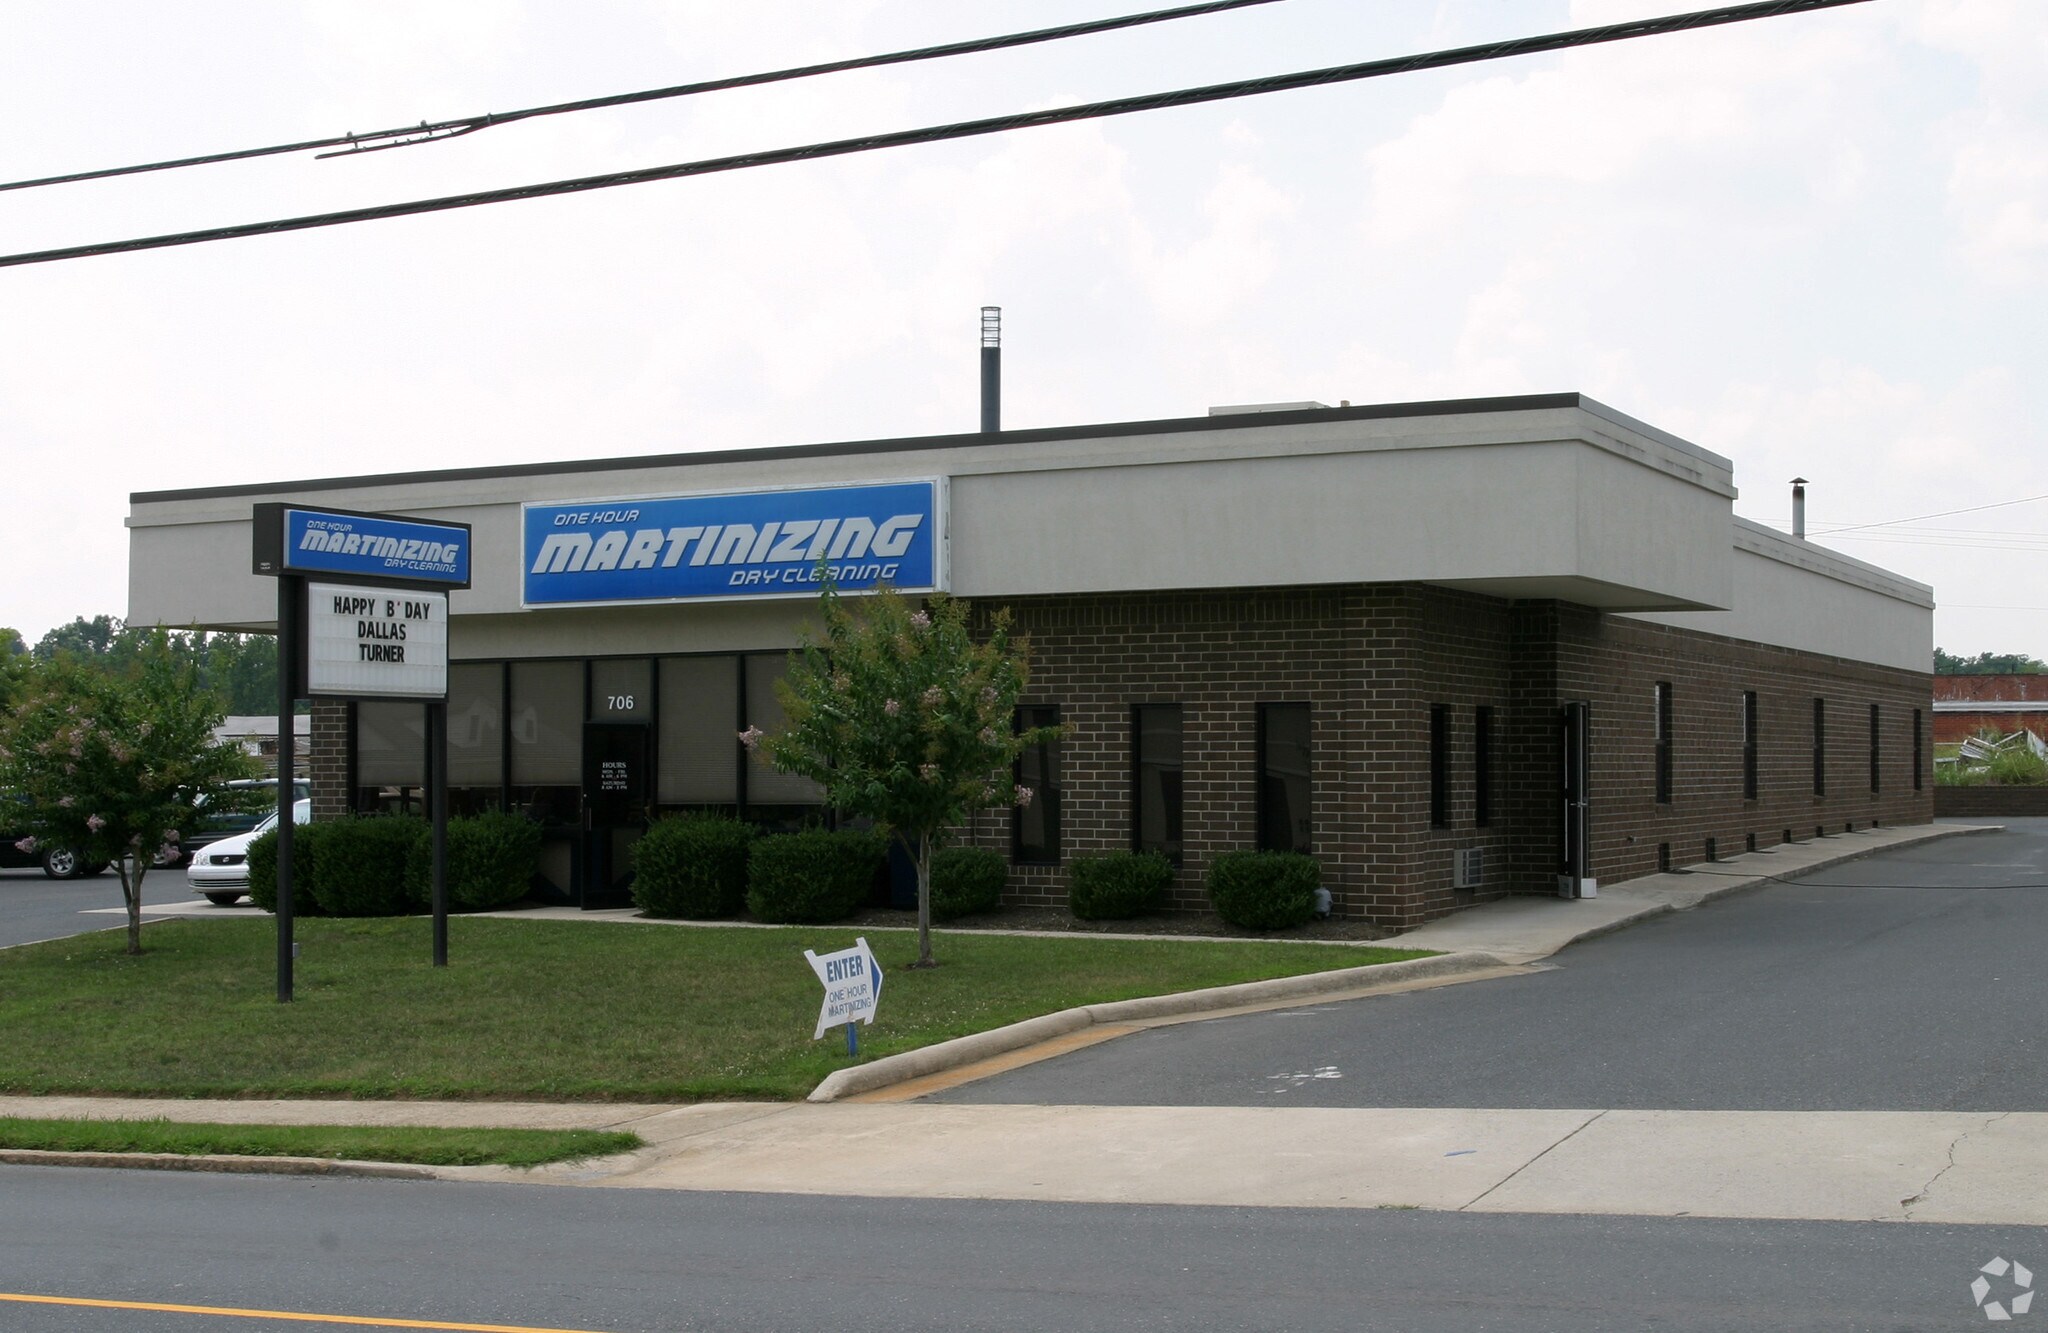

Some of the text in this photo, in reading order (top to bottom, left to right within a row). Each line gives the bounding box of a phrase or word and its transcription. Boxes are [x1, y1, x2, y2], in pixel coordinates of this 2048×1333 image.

[307, 520, 353, 532] ONE HOUR
[553, 509, 640, 526] ONE HOUR
[299, 529, 460, 564] MARTINIZING
[531, 513, 924, 575] MARTINIZING
[384, 558, 457, 573] DRY CLEANING
[728, 563, 899, 587] DRY CLEANING
[334, 596, 376, 616] HAPPY
[358, 620, 407, 641] DALLAS
[359, 643, 405, 663] TURNER
[607, 695, 634, 710] 706
[825, 955, 864, 983] ENTER
[828, 983, 868, 1003] ONE HOUR
[828, 997, 872, 1018] MARTINIZING
